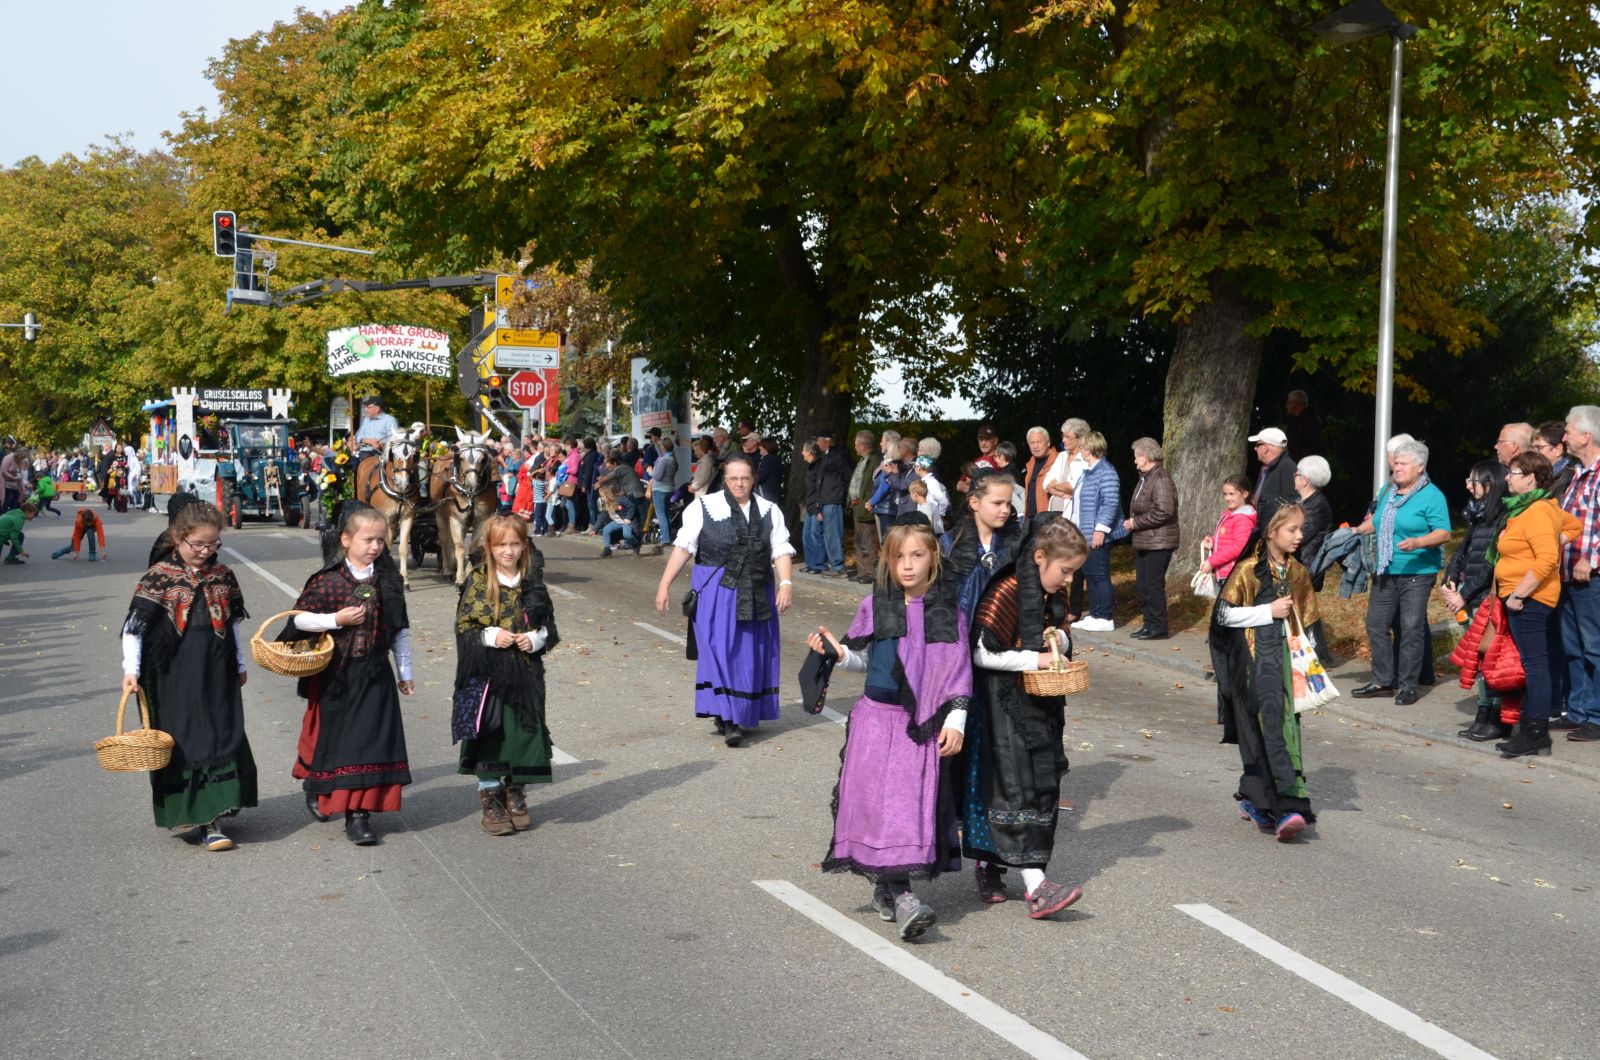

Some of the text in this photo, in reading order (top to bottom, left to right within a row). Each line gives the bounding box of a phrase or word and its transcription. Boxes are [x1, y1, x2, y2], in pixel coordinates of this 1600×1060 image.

[359, 325, 404, 336] HAMMEL
[371, 337, 415, 347] HORAFF
[330, 345, 350, 360] 175
[380, 348, 450, 365] FRÄNKISCHES
[328, 353, 360, 375] JAHRE
[391, 361, 449, 376] VOLKSFEST
[203, 389, 263, 400] GRUSELSCHLOSS
[512, 382, 542, 397] STOP
